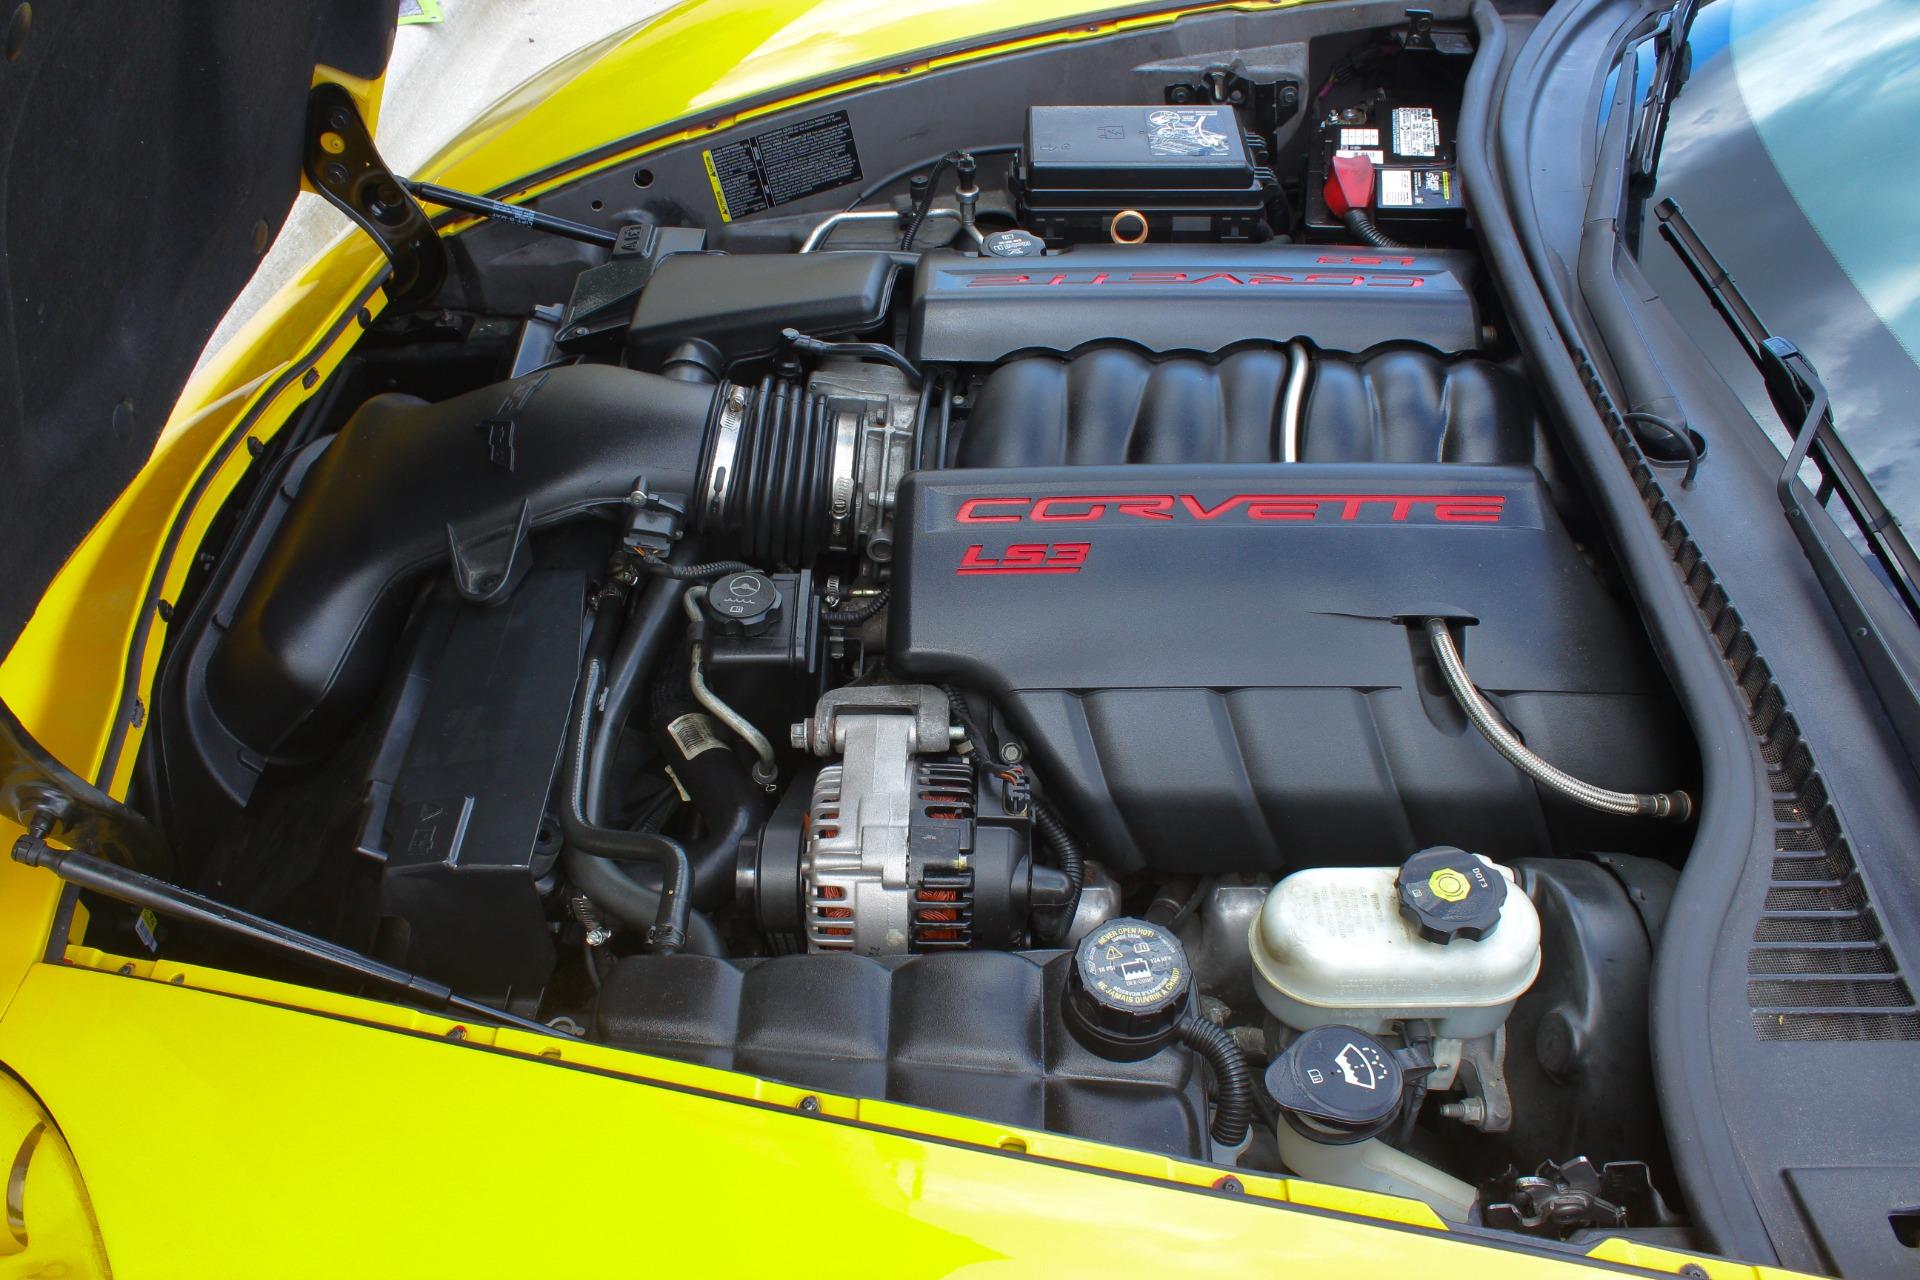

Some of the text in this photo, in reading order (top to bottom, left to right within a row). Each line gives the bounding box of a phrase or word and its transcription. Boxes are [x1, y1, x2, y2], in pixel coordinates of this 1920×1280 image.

[956, 494, 1505, 523] CORVETTE
[959, 542, 1091, 568] LS3
[1097, 927, 1155, 945] NEVER OPEN HOT!
[1096, 980, 1107, 991] NE
[1105, 988, 1135, 1003] JAMAIS
[1134, 991, 1162, 1004] OUVRIR
